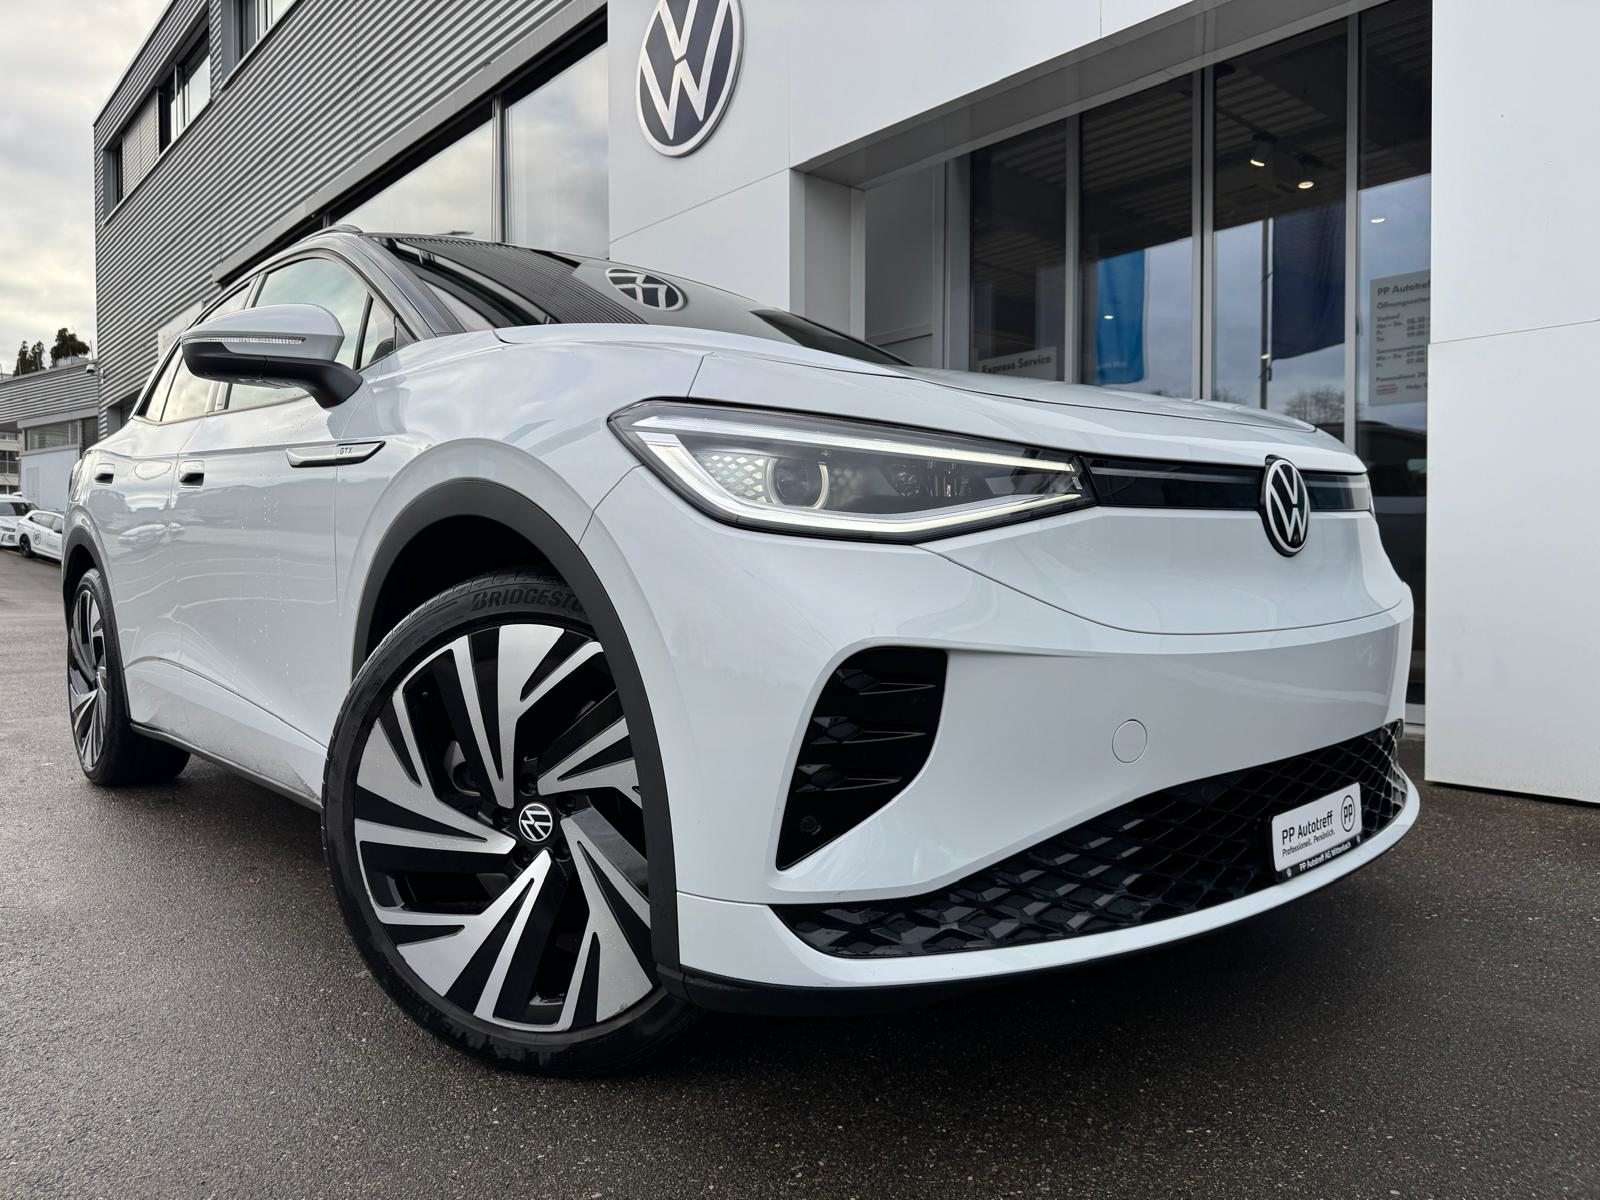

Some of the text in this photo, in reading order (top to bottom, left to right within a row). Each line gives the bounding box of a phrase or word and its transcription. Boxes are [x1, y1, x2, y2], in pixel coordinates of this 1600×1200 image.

[637, 0, 736, 150] VW
[1377, 286, 1390, 296] PP
[982, 354, 1052, 374] Express Service
[340, 447, 353, 455] GTX
[1266, 460, 1308, 550] VW
[1343, 803, 1353, 825] PP
[1281, 810, 1333, 846] PP Autotreff
[1282, 838, 1313, 857] Professionell.
